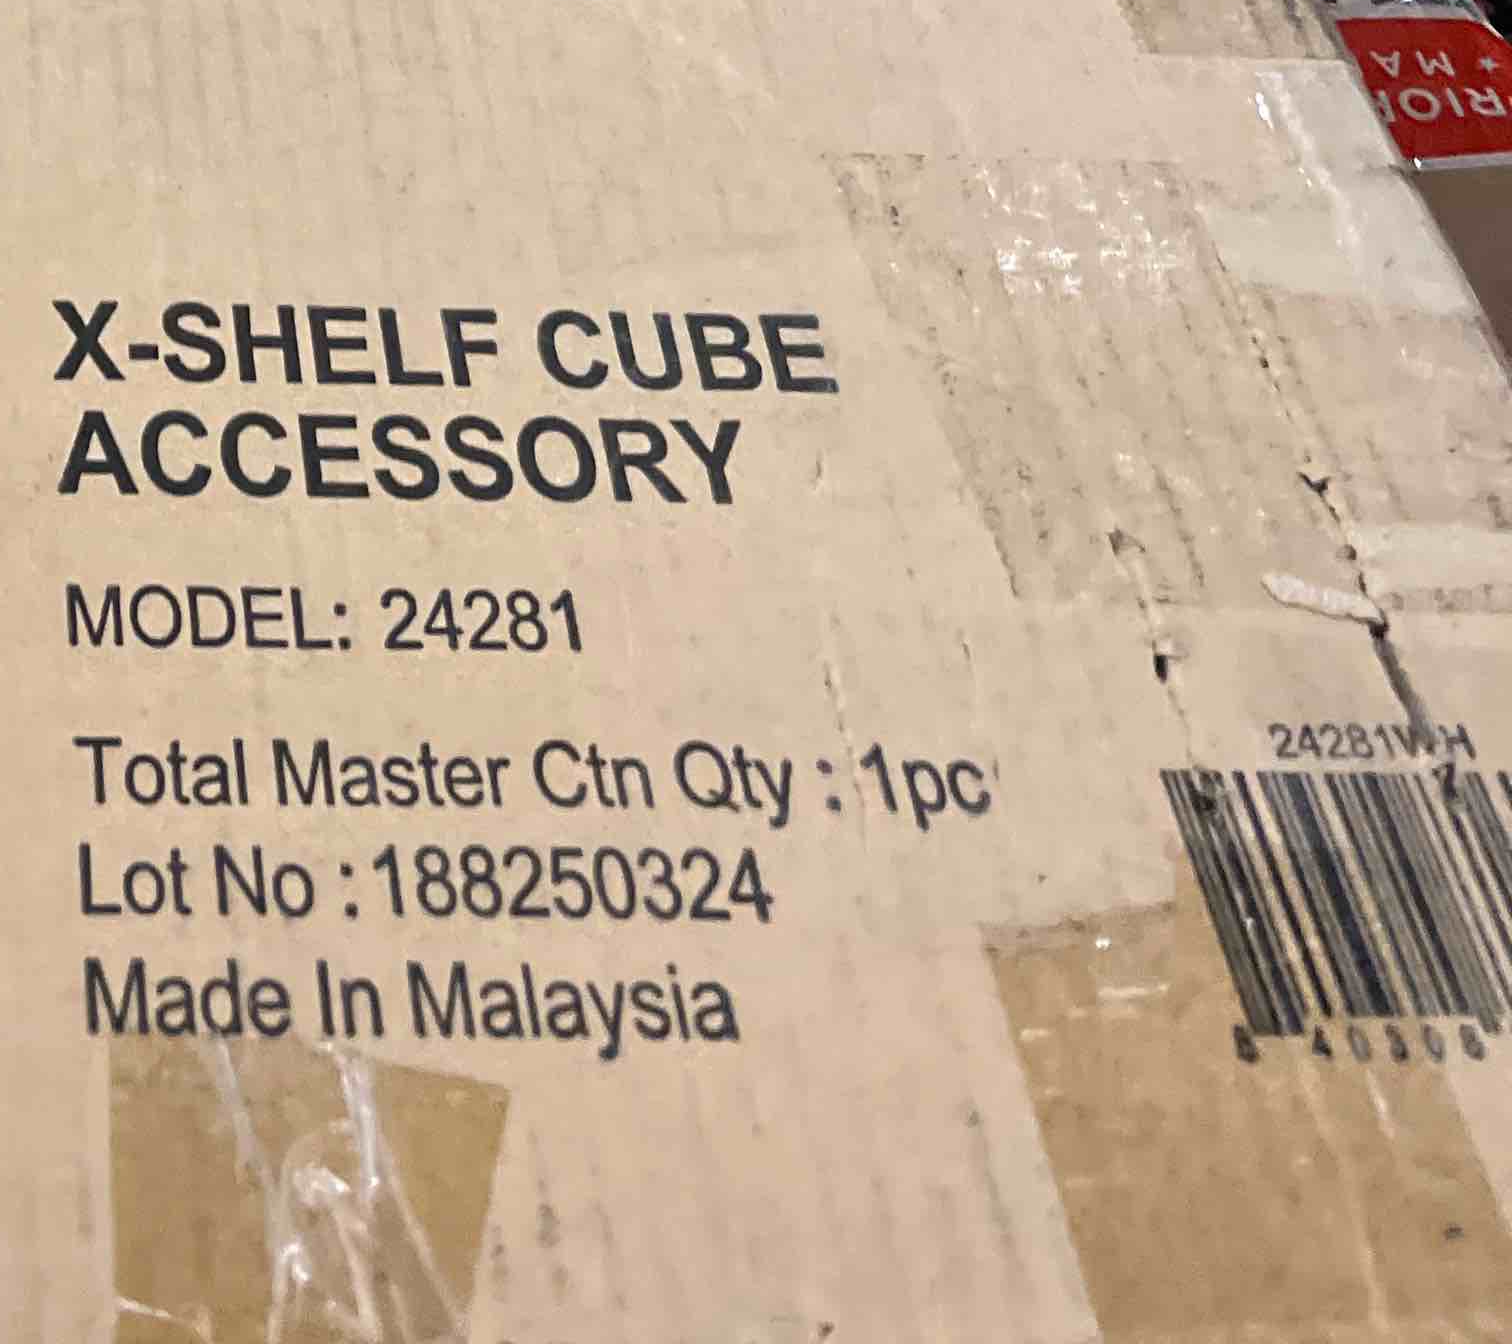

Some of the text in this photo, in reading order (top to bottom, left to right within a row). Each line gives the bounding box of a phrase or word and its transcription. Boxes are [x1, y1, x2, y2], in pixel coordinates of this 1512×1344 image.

[52, 300, 840, 395] X-SHELF CUBE
[57, 410, 742, 505] ACCESSORY
[66, 583, 583, 653] MODEL: 24281
[73, 736, 249, 806] Total
[272, 738, 511, 808] Master
[533, 739, 655, 809] Ctn
[674, 740, 793, 829] Qty
[78, 843, 193, 916] Lot
[213, 844, 316, 918] No
[85, 958, 741, 1061] Made In Malaysia
